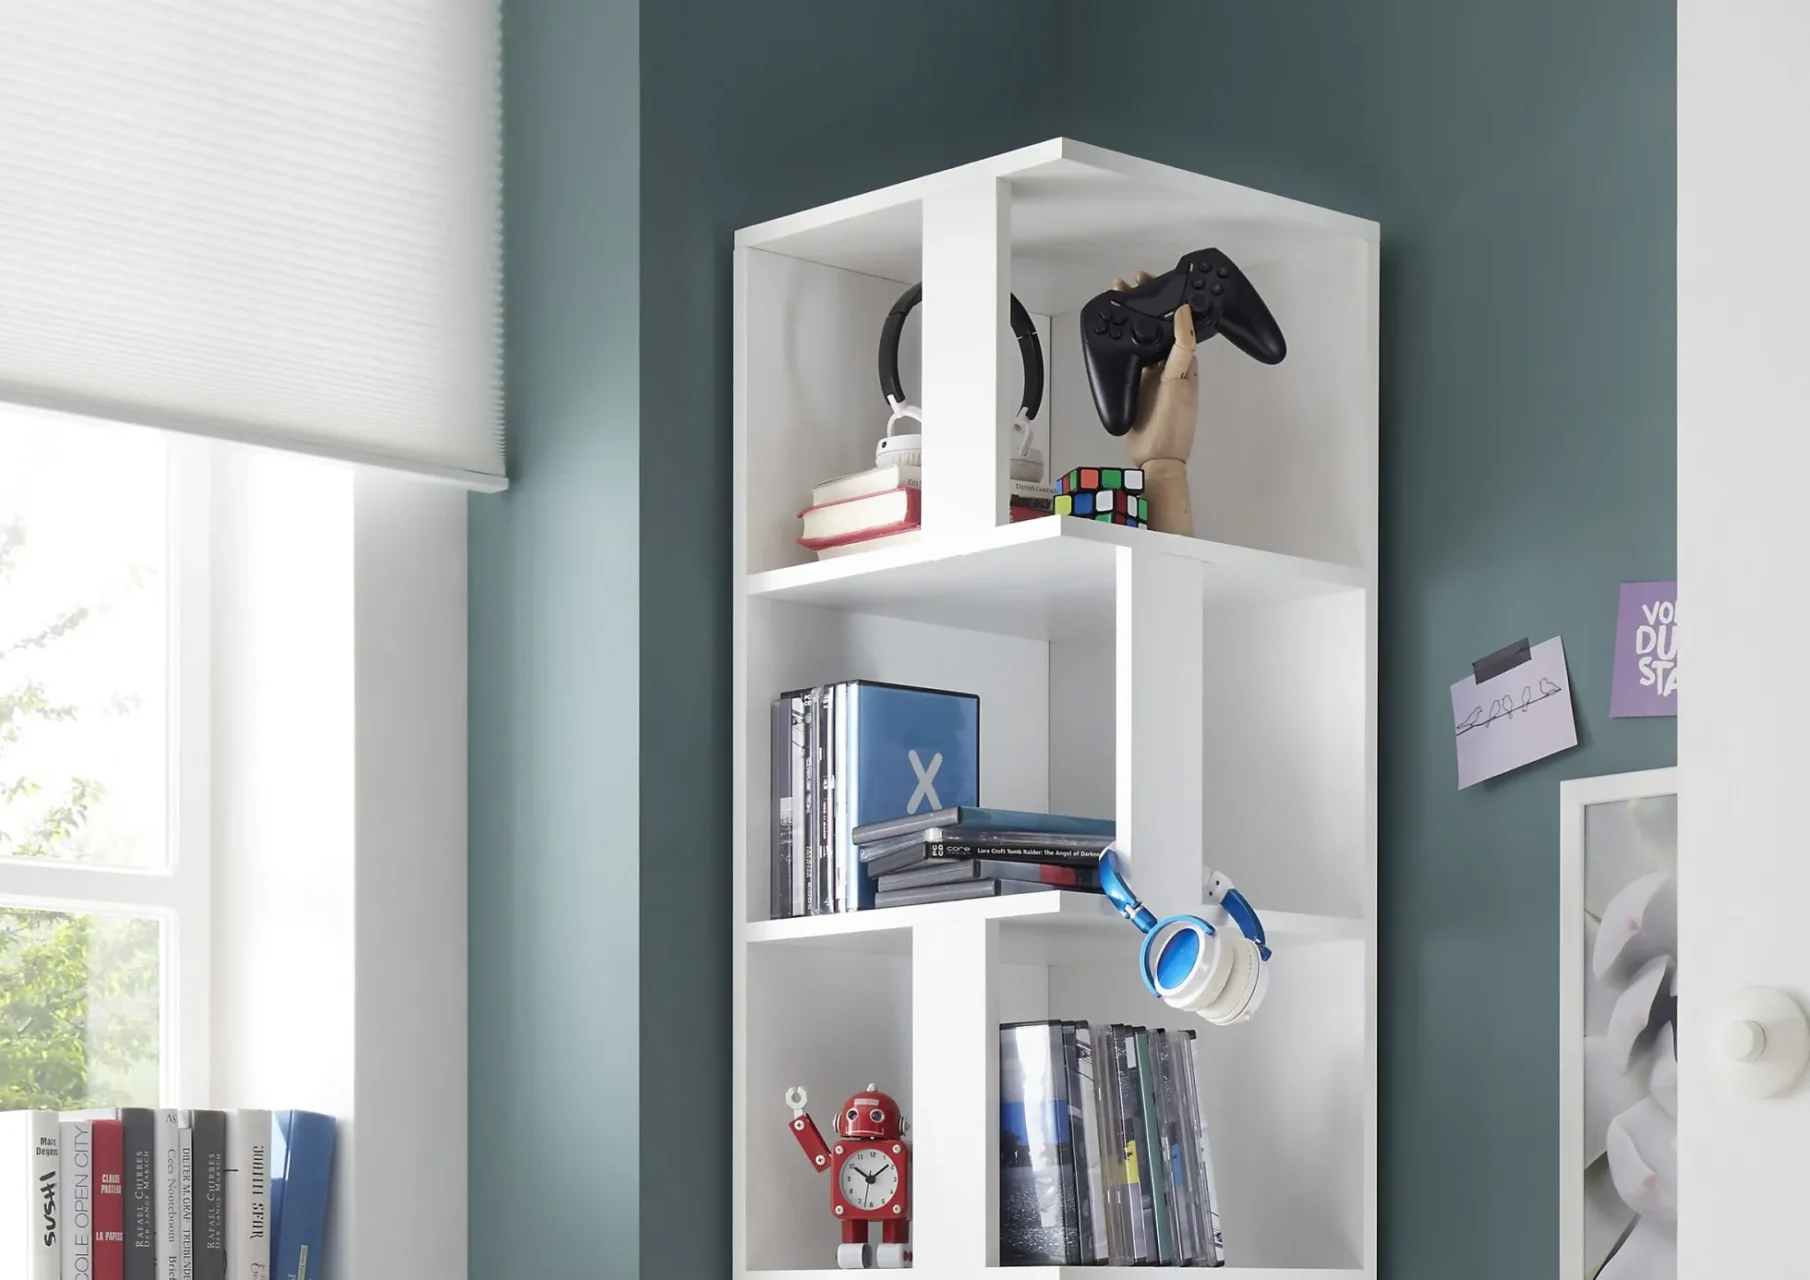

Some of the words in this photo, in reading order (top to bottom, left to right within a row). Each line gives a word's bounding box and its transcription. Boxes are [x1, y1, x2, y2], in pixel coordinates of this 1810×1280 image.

[1642, 601, 1677, 625] VO
[907, 750, 943, 814] X
[36, 1147, 59, 1157] Degens
[40, 1137, 57, 1146] Marc
[74, 1125, 89, 1168] CITY
[167, 1149, 176, 1175] Cees
[134, 1151, 144, 1199] CHIRBES
[182, 1148, 191, 1181] DIETER
[207, 1154, 215, 1201] CHIRBES
[39, 1171, 57, 1247] SUSHI
[75, 1174, 89, 1228] OPEN
[182, 1184, 191, 1195] M.
[182, 1197, 191, 1221] GRAF
[135, 1205, 144, 1247] RAFAEL
[168, 1179, 177, 1242] Nooteboom
[207, 1208, 215, 1249] RAFAEL
[96, 1231, 104, 1241] LA
